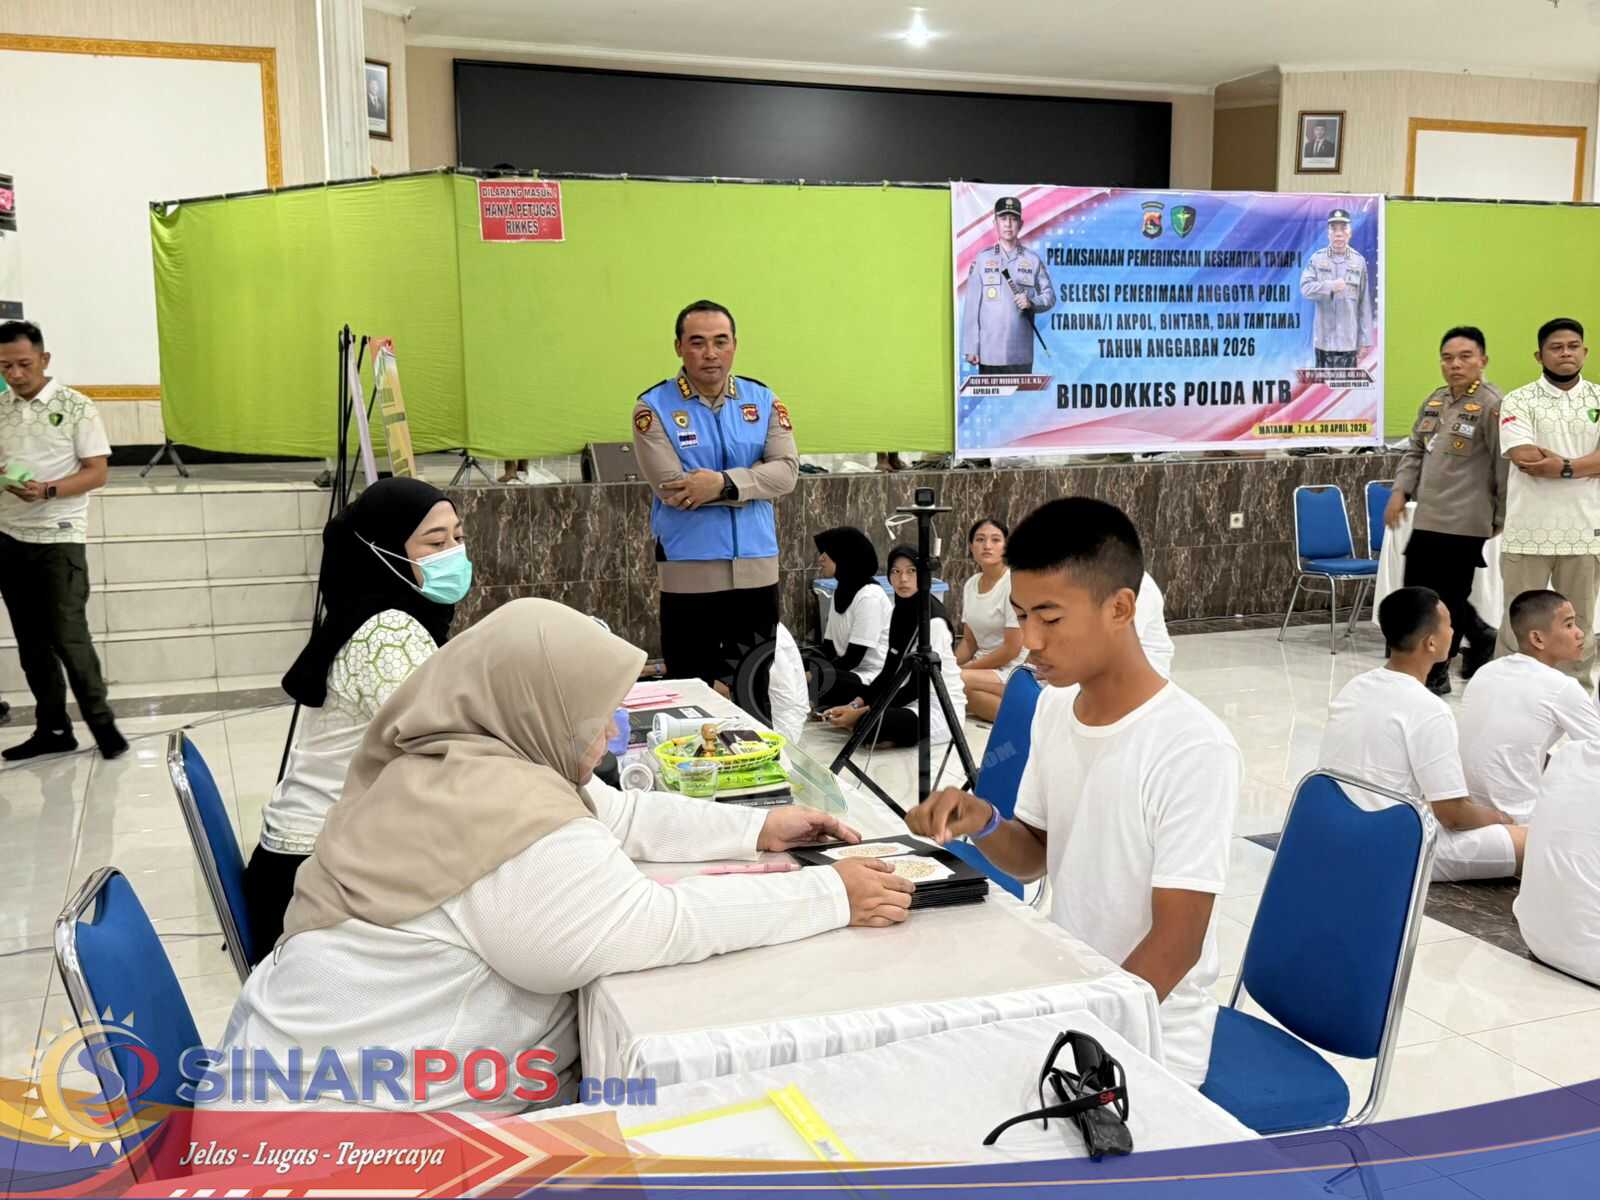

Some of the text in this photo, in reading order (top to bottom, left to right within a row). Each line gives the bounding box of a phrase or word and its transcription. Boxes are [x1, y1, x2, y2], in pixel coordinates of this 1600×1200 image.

[482, 187, 522, 198] DILARANG
[485, 203, 557, 217] HANYA PETUGAS
[506, 221, 538, 233] RIKKES
[1047, 248, 1124, 266] PELAKSANAAN
[1127, 250, 1201, 267] PEMERIKSAAN
[1204, 250, 1260, 268] KESEHATAN
[1060, 284, 1290, 302] SELEKSI PENERIMAAN ANGGOTA POLRI
[1116, 313, 1157, 331] AKPOL,
[1160, 313, 1214, 331] BINTARA,
[1217, 313, 1240, 329] DAN
[1098, 337, 1255, 358] TAHUN ANGGARAN 2026
[1056, 380, 1292, 409] BIDDOKKES POLDA NTB
[1330, 424, 1349, 432] APRIL
[1351, 423, 1367, 432] 2026
